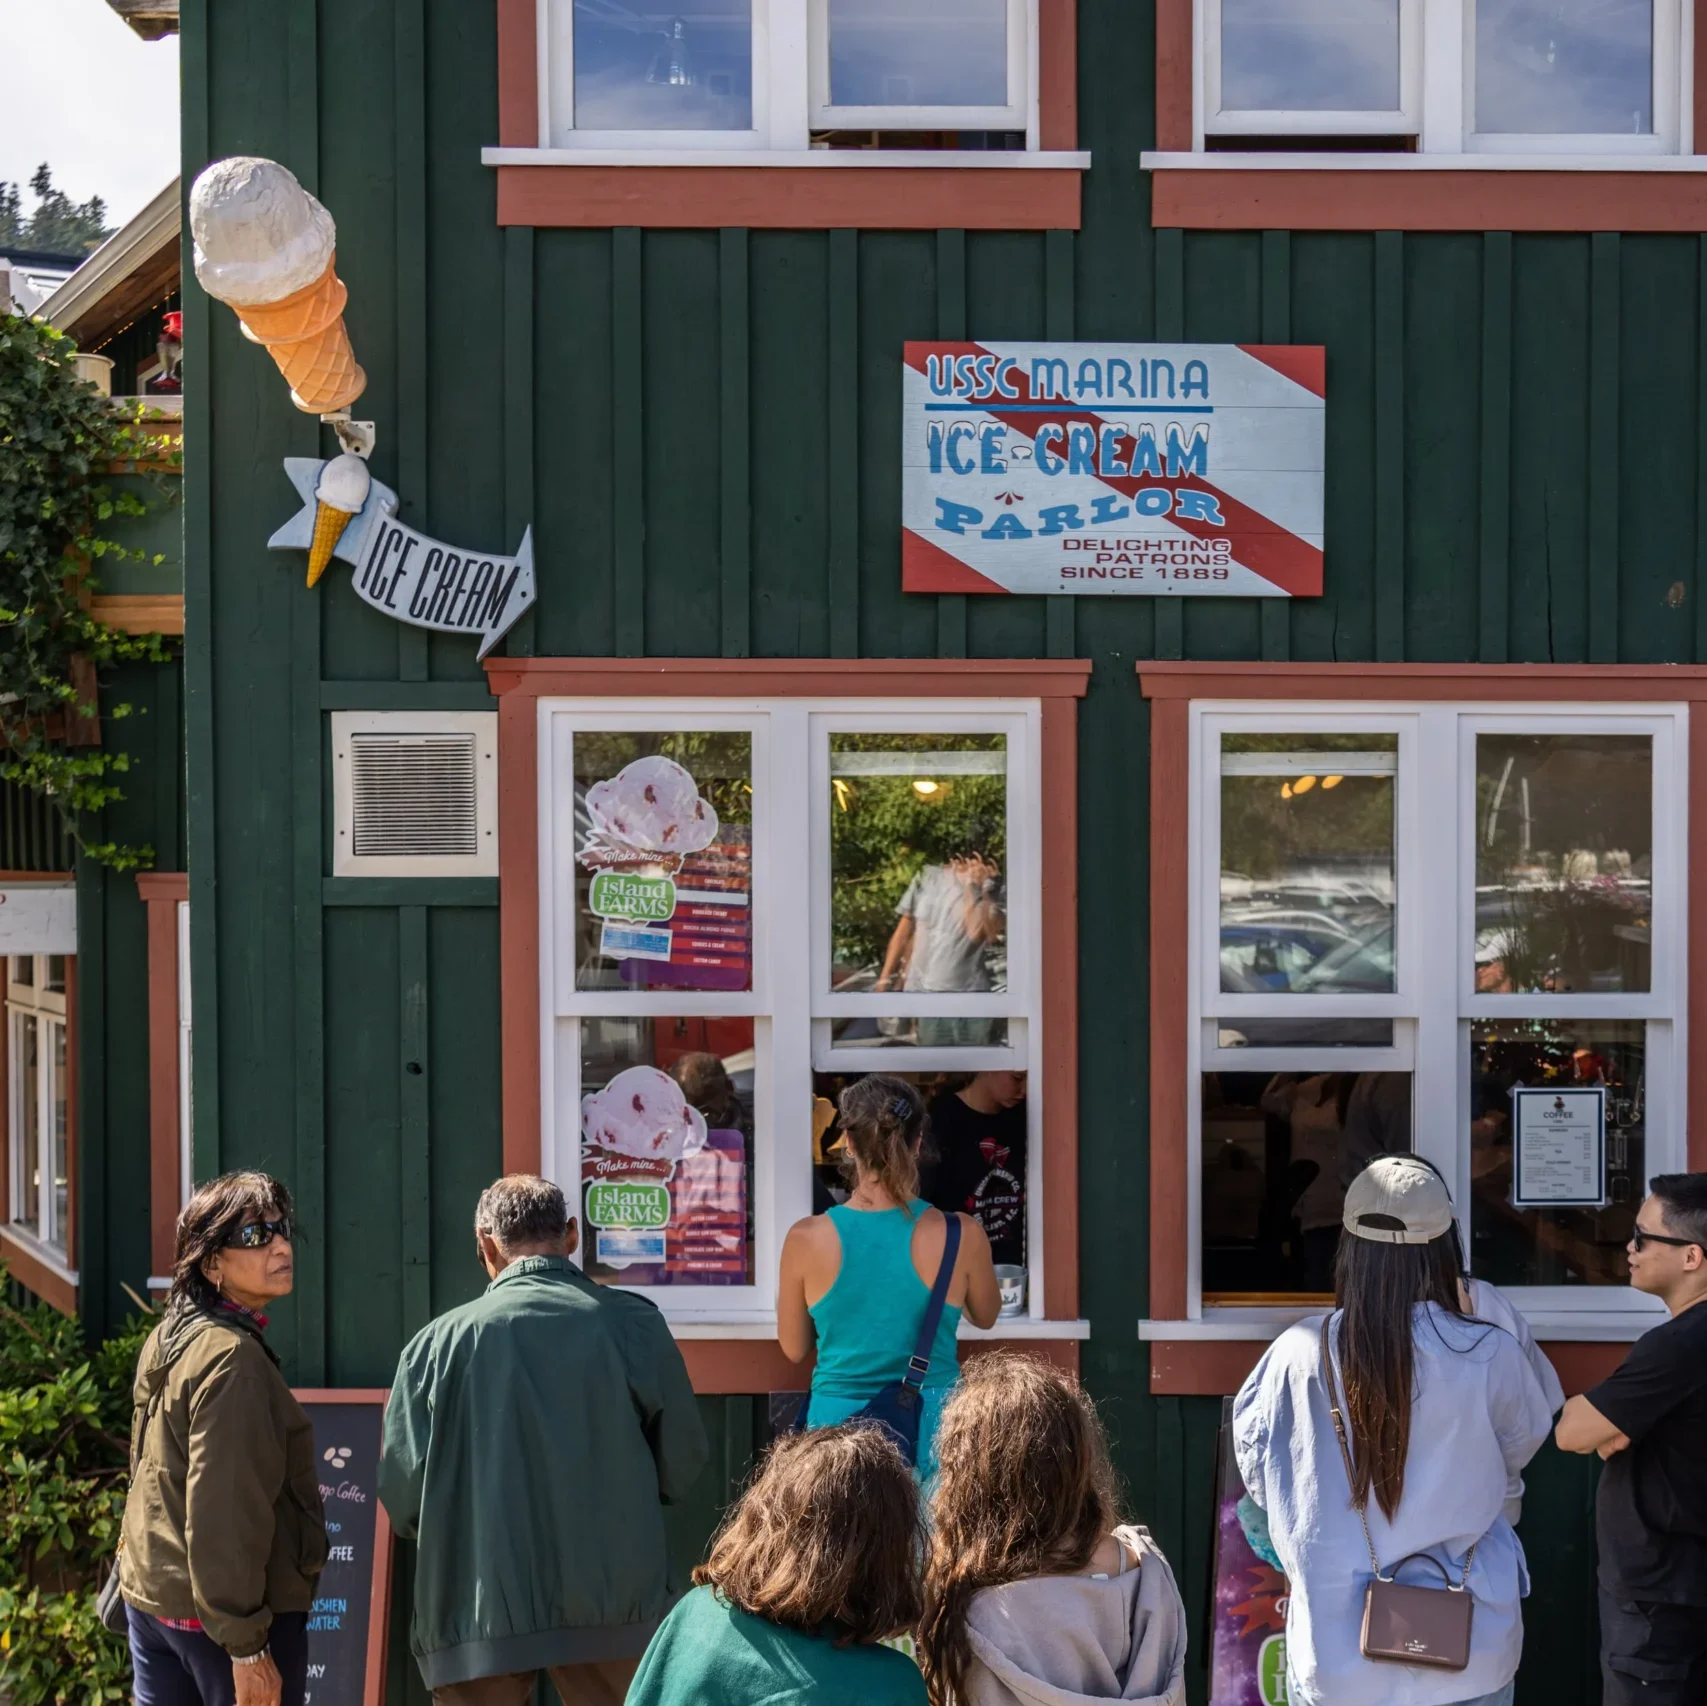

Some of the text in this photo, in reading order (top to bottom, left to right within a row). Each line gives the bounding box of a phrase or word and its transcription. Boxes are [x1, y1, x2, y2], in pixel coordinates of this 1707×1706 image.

[927, 354, 1210, 400] USSC MARINA
[934, 488, 1226, 540] PARLOR
[1063, 539, 1232, 553] DELIGHTING
[1095, 553, 1230, 566] PATRONS
[360, 520, 521, 629] ICE CREAM
[1060, 566, 1230, 580] SINCE 1889
[604, 849, 638, 863] Make
[601, 877, 667, 899] island
[598, 894, 669, 916] FARMS
[1543, 1111, 1574, 1119] COFFEE
[596, 1158, 630, 1175] Make
[596, 1187, 660, 1206] island
[594, 1204, 663, 1223] FARMS
[337, 1480, 366, 1503] Coffee
[309, 1597, 347, 1613] NSHEN
